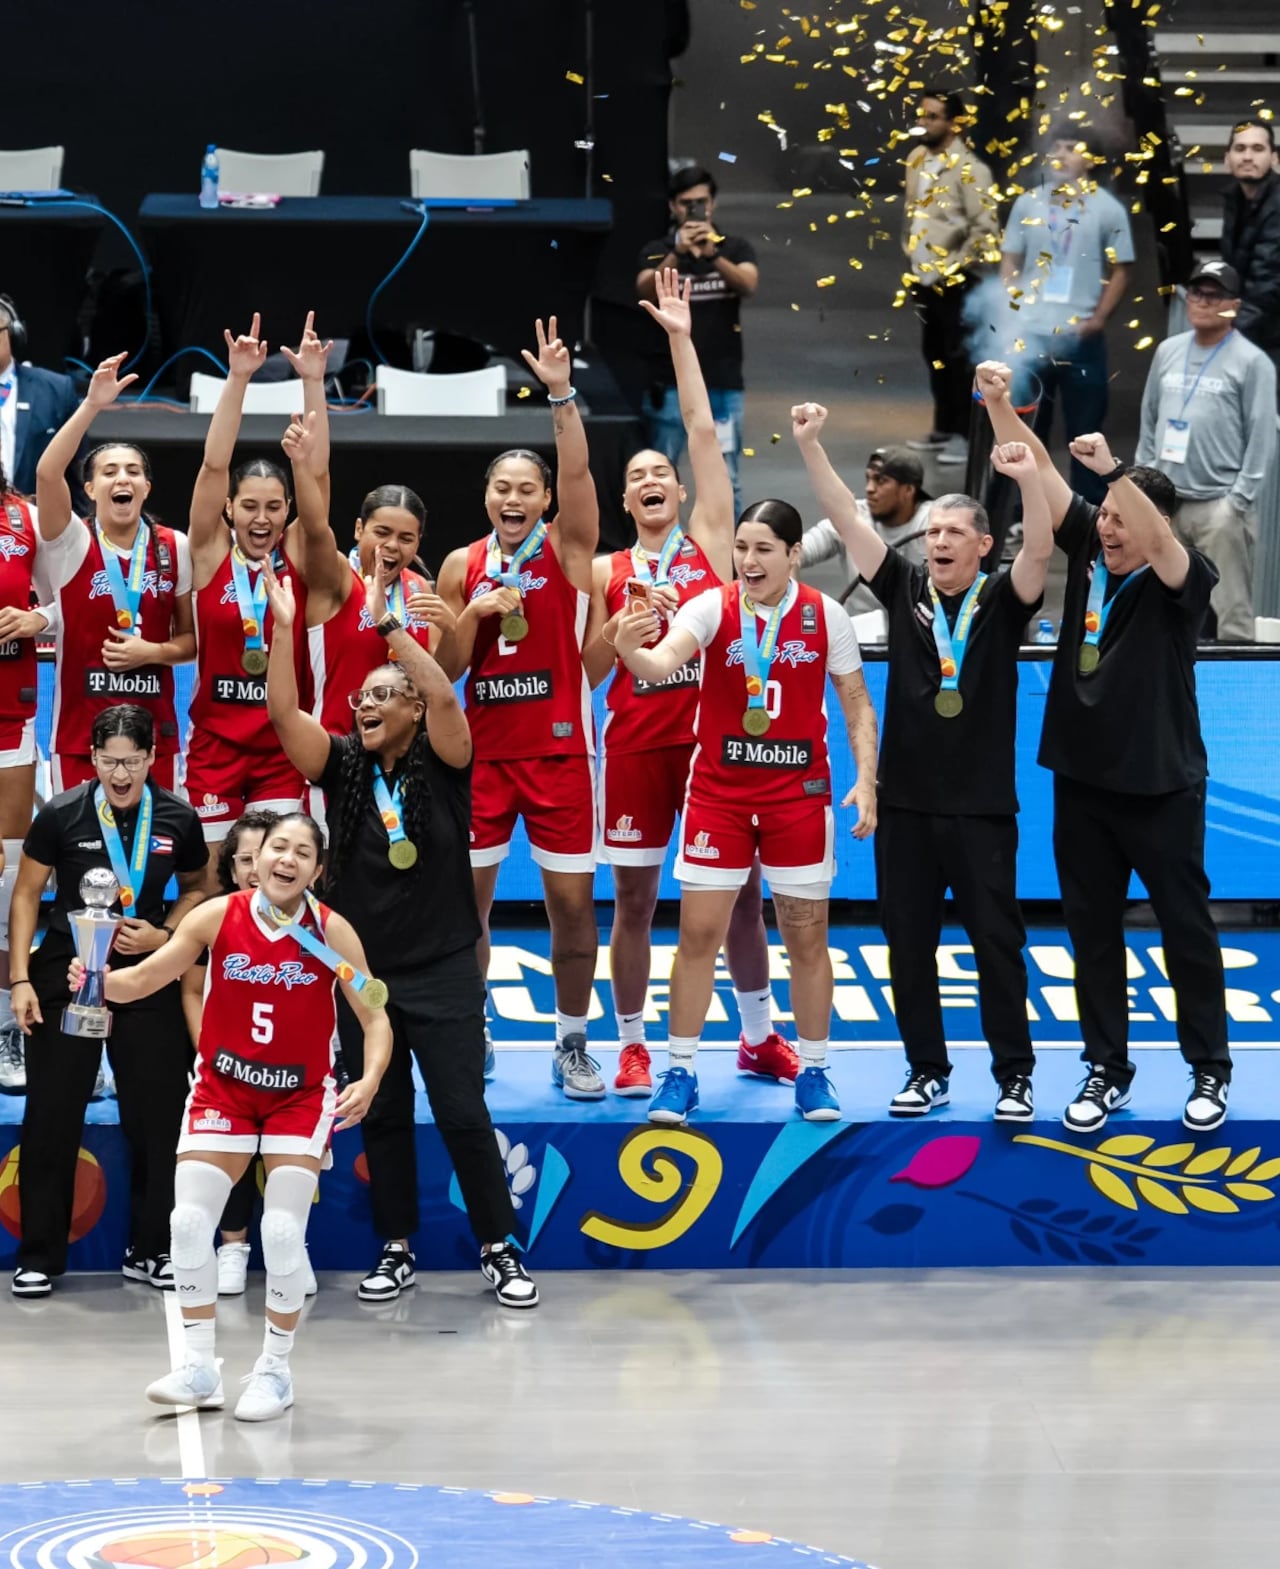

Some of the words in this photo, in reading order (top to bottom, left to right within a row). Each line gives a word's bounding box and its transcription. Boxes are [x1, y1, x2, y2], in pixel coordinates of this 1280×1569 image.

[671, 563, 706, 589] Rico
[778, 641, 818, 668] Rico
[487, 677, 549, 700] Mobile
[744, 742, 808, 765] Mobile
[196, 803, 229, 814] OTERIA
[224, 953, 276, 986] Puerto
[273, 961, 318, 992] Rico
[251, 1001, 274, 1045] 5
[233, 1060, 299, 1089] Mobile
